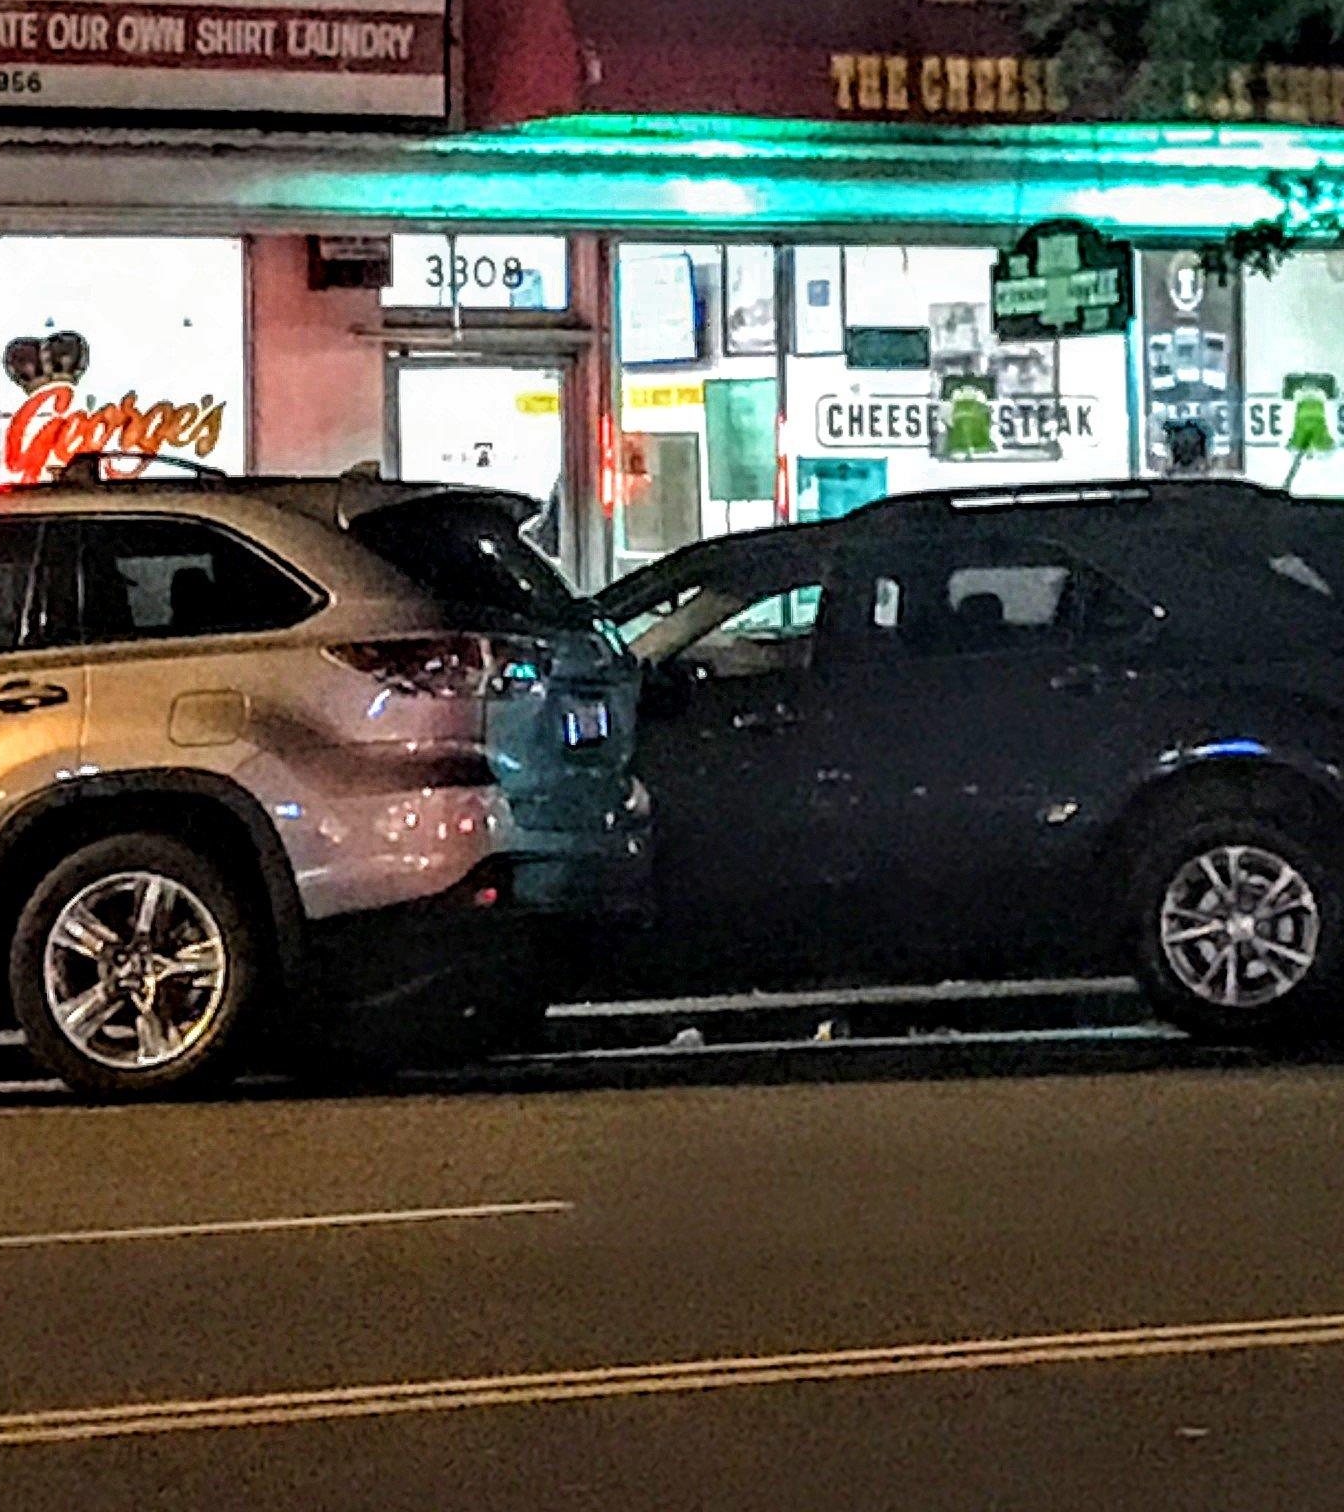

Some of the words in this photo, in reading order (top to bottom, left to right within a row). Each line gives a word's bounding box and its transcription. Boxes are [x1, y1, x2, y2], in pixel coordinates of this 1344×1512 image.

[47, 13, 109, 51] OUR
[117, 15, 185, 54] OWN
[196, 18, 278, 56] SHIRT
[287, 18, 414, 60] LAUNDRY
[830, 54, 908, 110] THE
[425, 255, 522, 288] 3308
[827, 403, 941, 438] CHEESE
[997, 403, 1093, 437] STEAK
